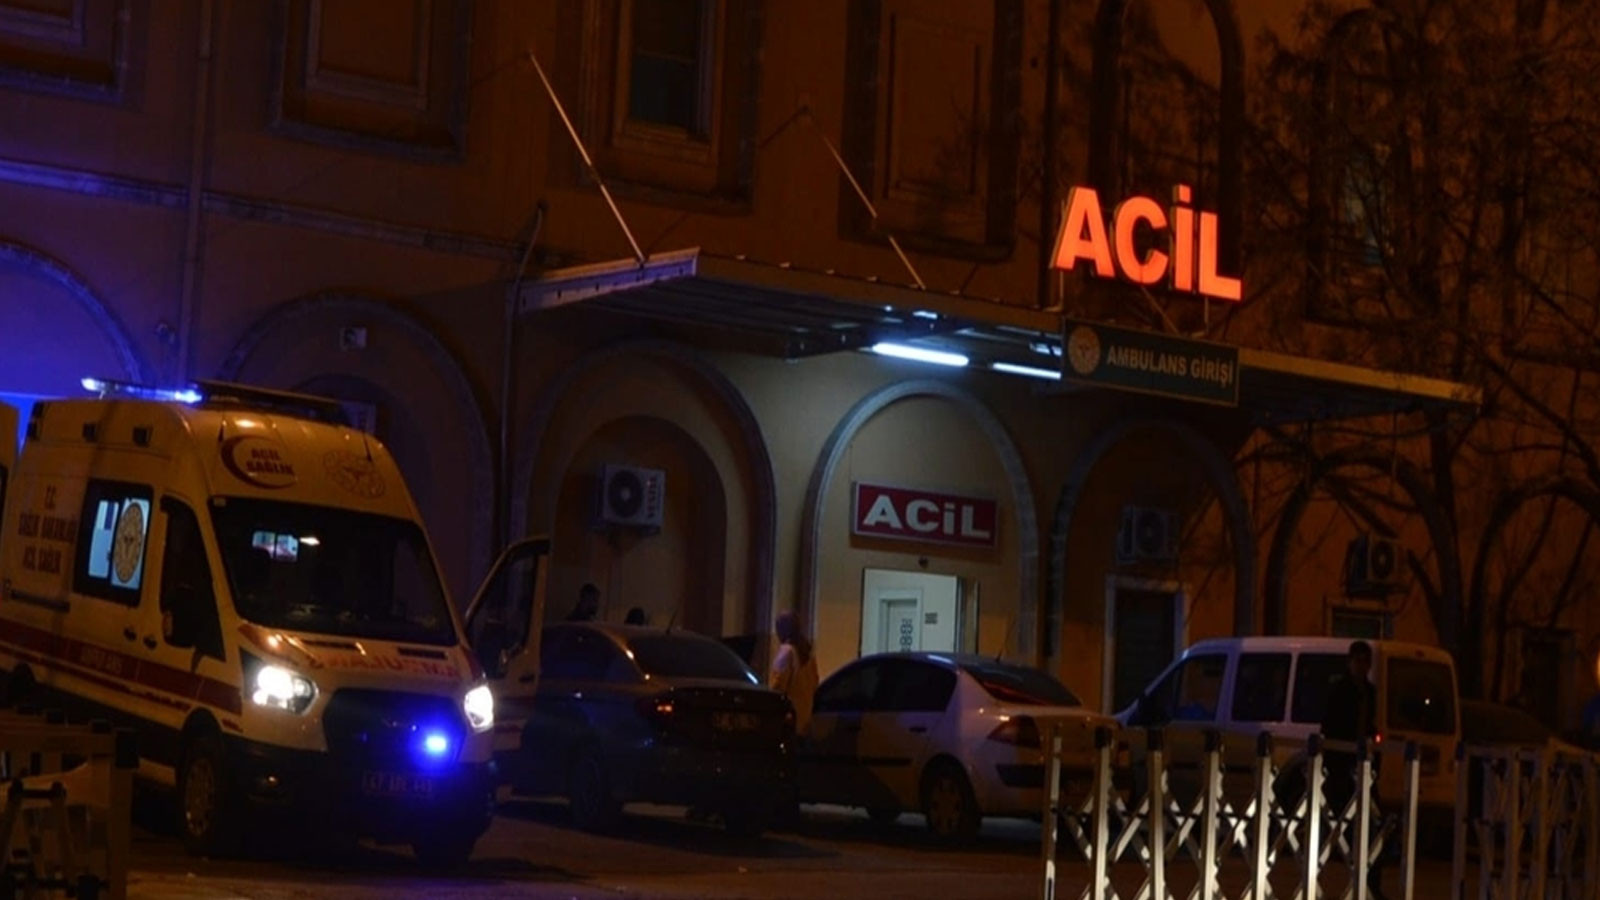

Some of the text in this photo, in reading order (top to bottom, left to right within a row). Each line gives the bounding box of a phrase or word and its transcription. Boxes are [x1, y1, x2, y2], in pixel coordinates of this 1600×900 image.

[1056, 184, 1242, 301] ACİL
[1107, 346, 1234, 388] AMBULANS GİRİŞİ
